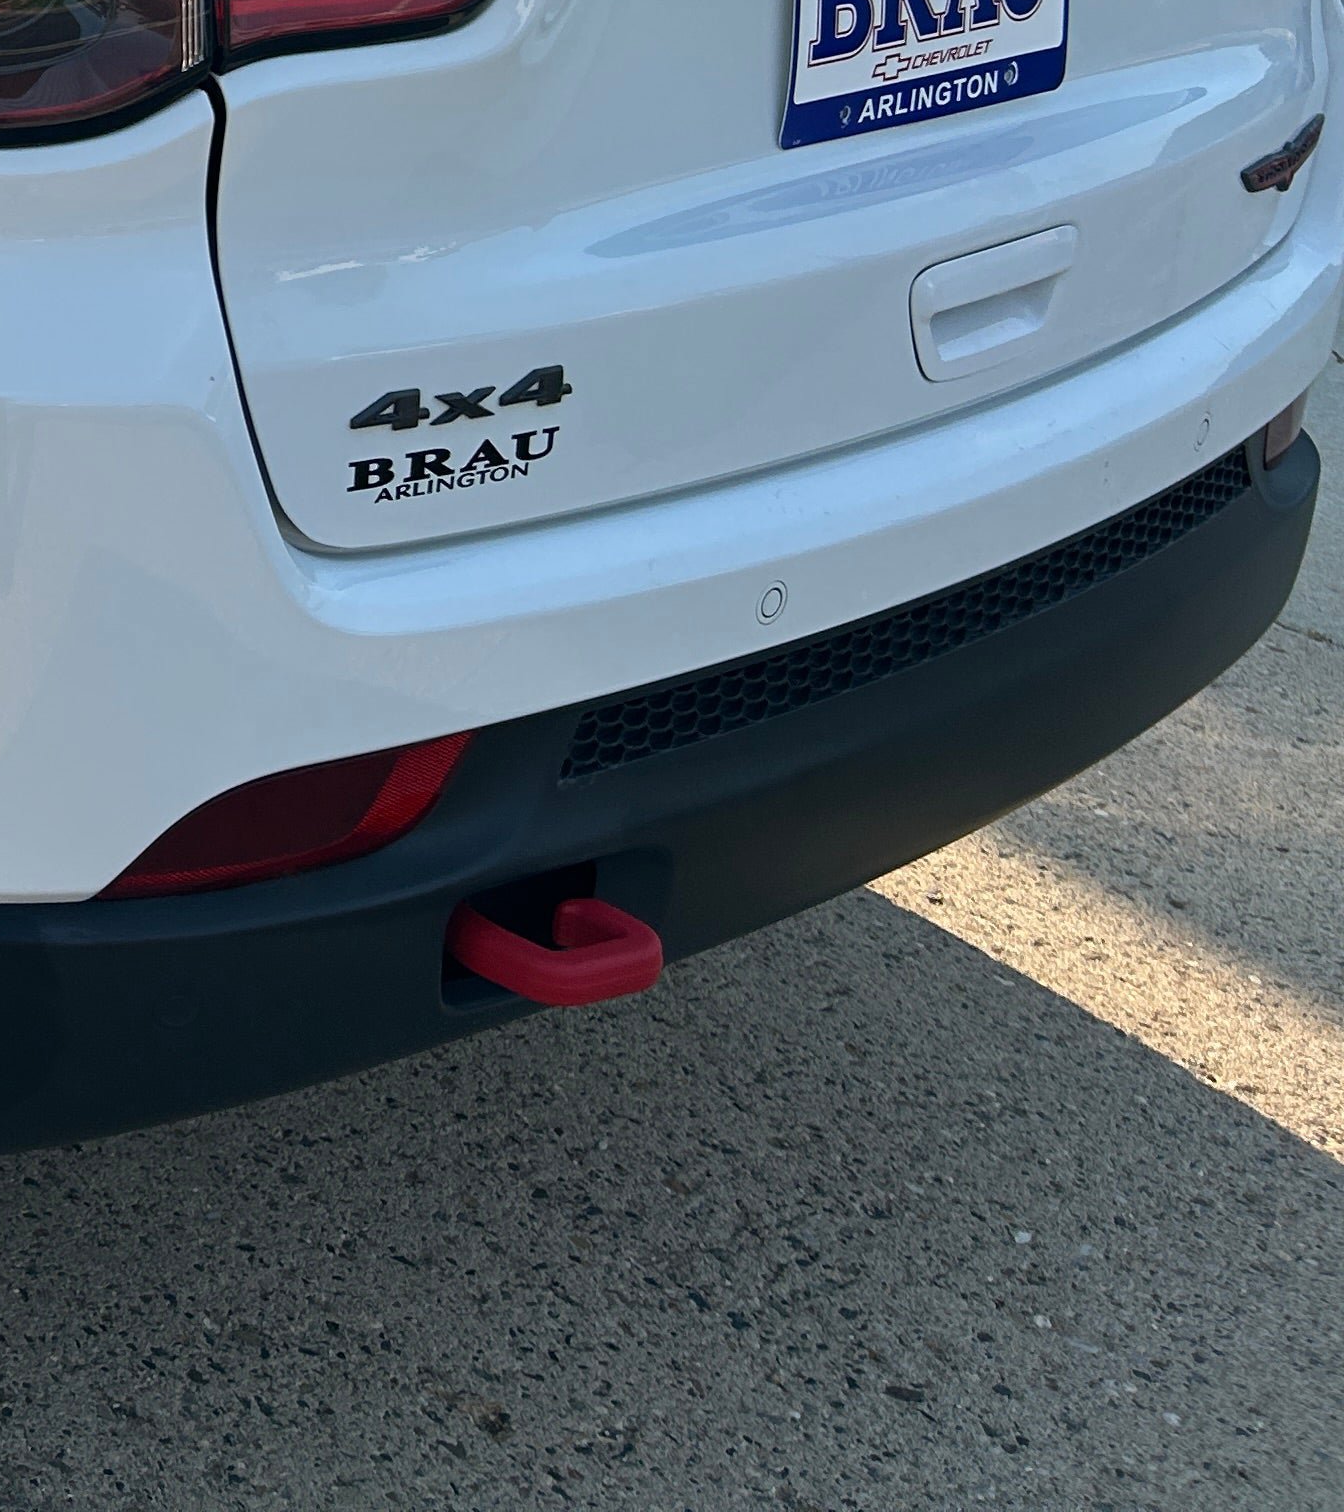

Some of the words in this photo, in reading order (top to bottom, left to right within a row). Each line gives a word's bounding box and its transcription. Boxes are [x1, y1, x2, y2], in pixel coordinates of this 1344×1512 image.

[911, 39, 994, 70] CHEVROLET
[858, 70, 999, 124] ARLINGTON
[350, 364, 572, 431] 4x4
[347, 426, 560, 493] BRAU
[374, 462, 529, 504] ARLINGTON
